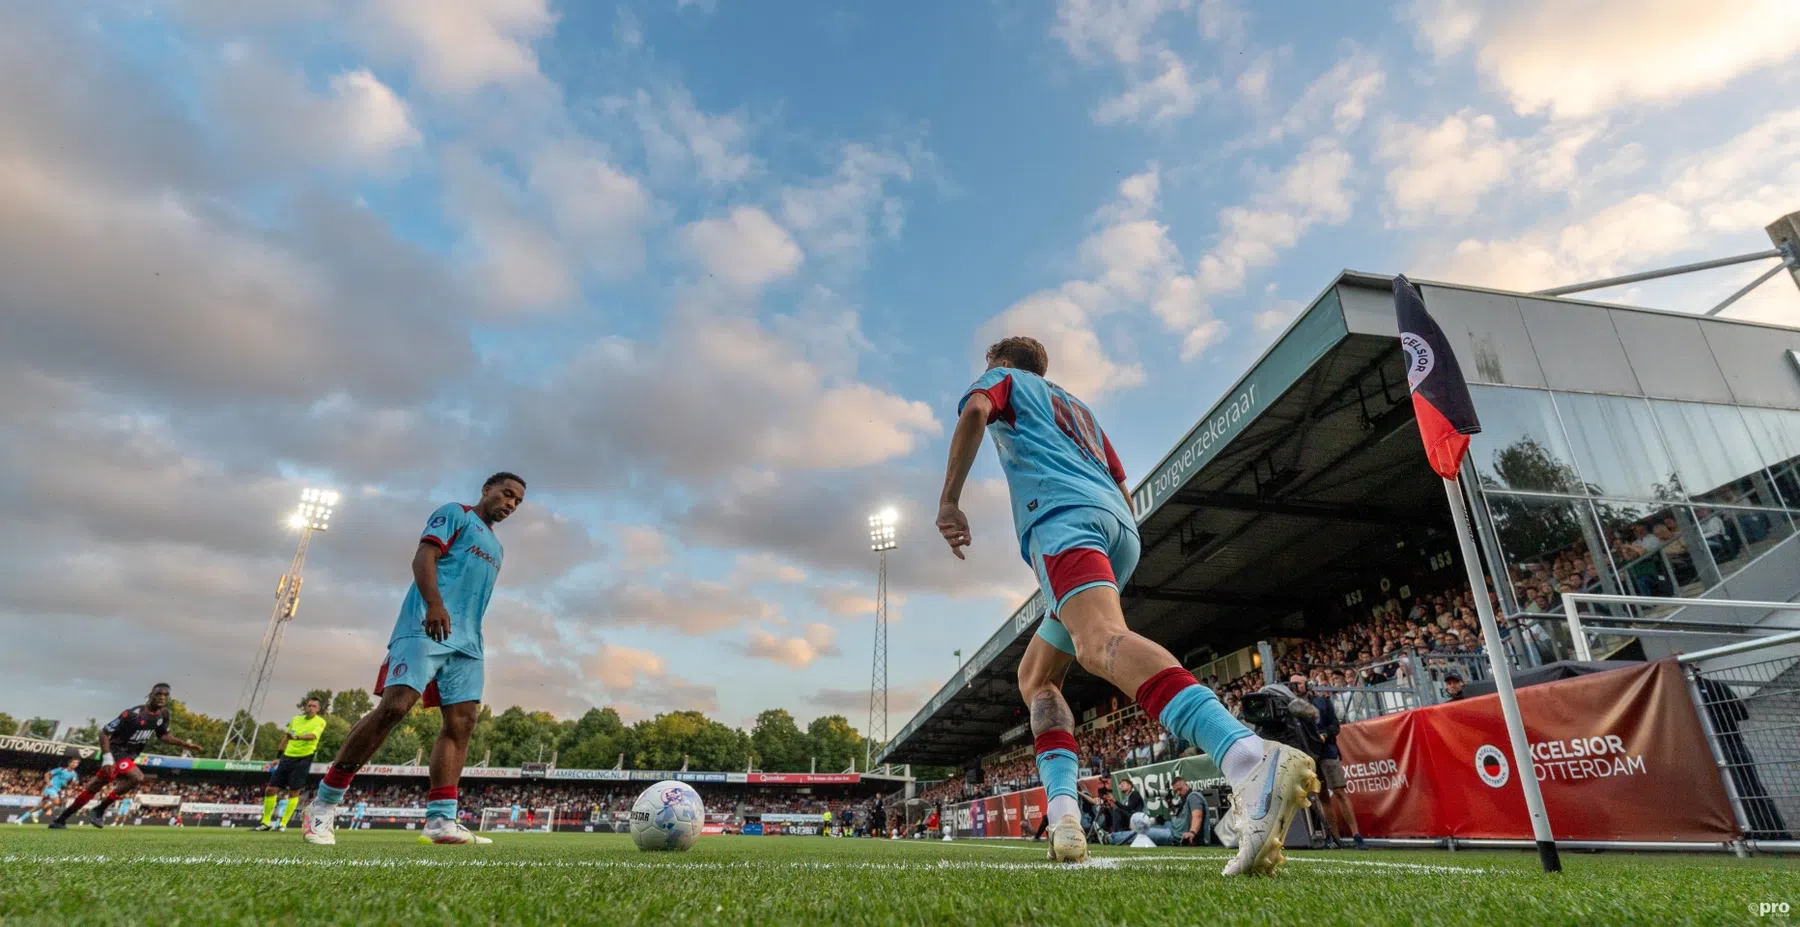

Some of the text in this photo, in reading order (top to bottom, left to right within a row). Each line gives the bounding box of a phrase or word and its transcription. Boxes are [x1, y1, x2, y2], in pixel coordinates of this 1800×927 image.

[1403, 337, 1428, 372] CELSIOR
[1155, 384, 1255, 496] zorgverzekeraar
[1015, 598, 1036, 634] DSW
[0, 739, 67, 756] UTOMOTIVE
[1529, 735, 1626, 760] XCELSIOR
[1342, 759, 1398, 778] XCELSIOR
[1534, 755, 1646, 781] OTTERDAM
